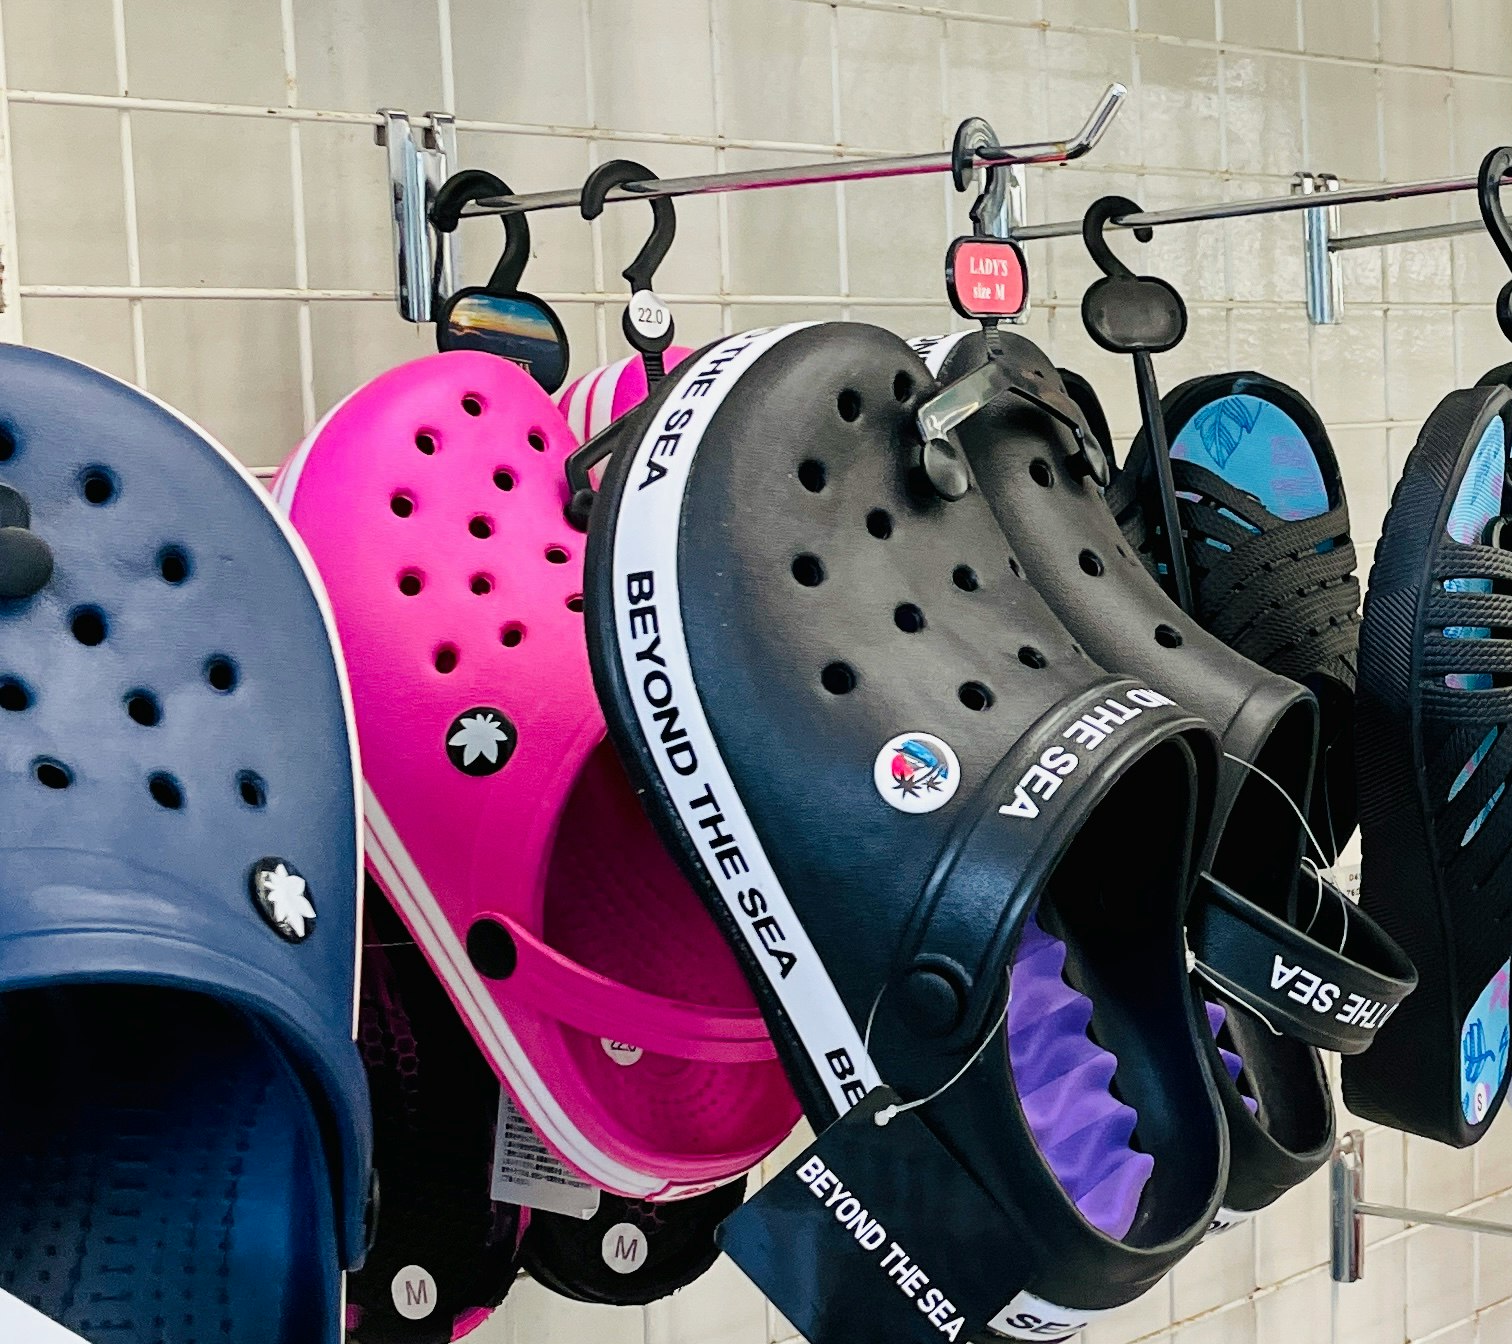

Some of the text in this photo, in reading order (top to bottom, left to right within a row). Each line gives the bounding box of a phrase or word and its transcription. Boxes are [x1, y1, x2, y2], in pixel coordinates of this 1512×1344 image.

[969, 256, 1008, 277] LADY'S
[973, 282, 1006, 301] size M
[638, 307, 664, 325] 22.0
[638, 342, 753, 492] THE SEA
[626, 570, 798, 979] BEYOND THE SEA
[998, 698, 1144, 819] THE SEA
[1270, 955, 1341, 1013] SEA
[1335, 996, 1385, 1029] THE
[615, 1235, 638, 1262] M
[796, 1155, 886, 1251] BEYOND
[880, 1244, 930, 1297] THE
[917, 1289, 968, 1343] SEA
[404, 1278, 427, 1309] M
